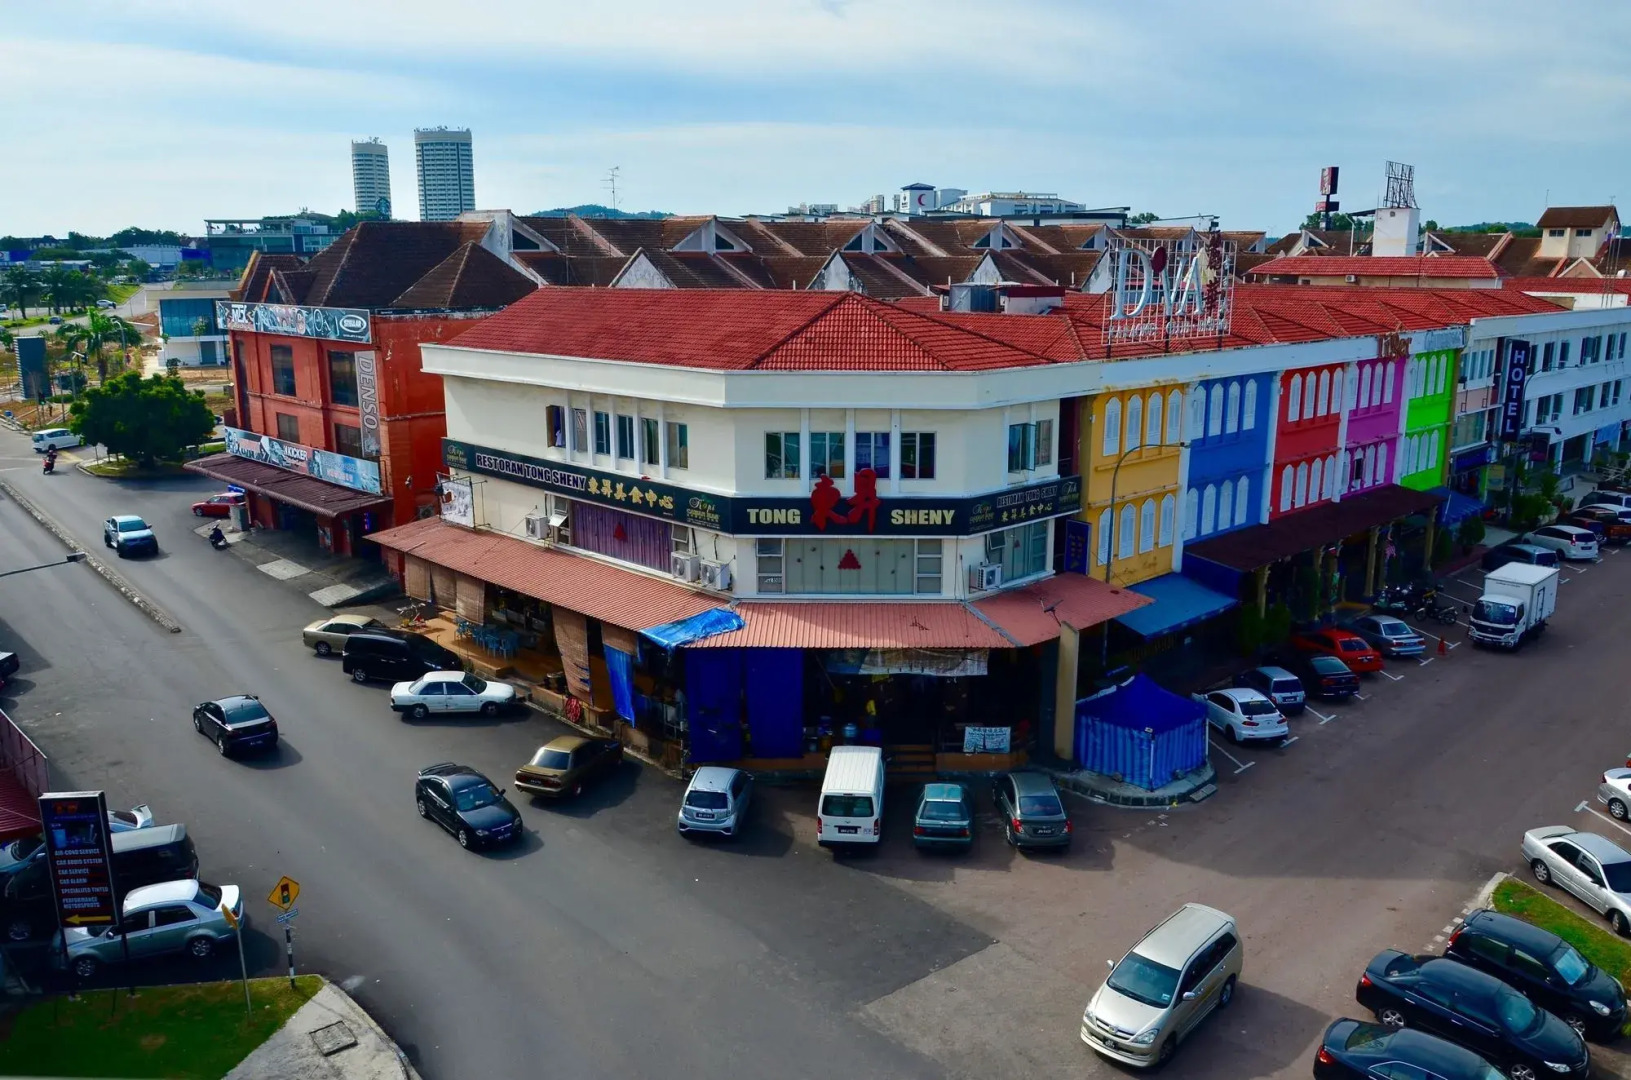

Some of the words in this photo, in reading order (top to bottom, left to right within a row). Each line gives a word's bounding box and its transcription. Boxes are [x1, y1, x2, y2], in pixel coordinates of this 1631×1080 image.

[360, 356, 378, 430] DENSO
[1505, 350, 1525, 432] HOTEL
[475, 453, 525, 477] RESTORAN
[525, 463, 551, 482] TONG
[552, 470, 586, 491] SHENY
[747, 508, 801, 524] TONG
[891, 509, 955, 525] SHENY
